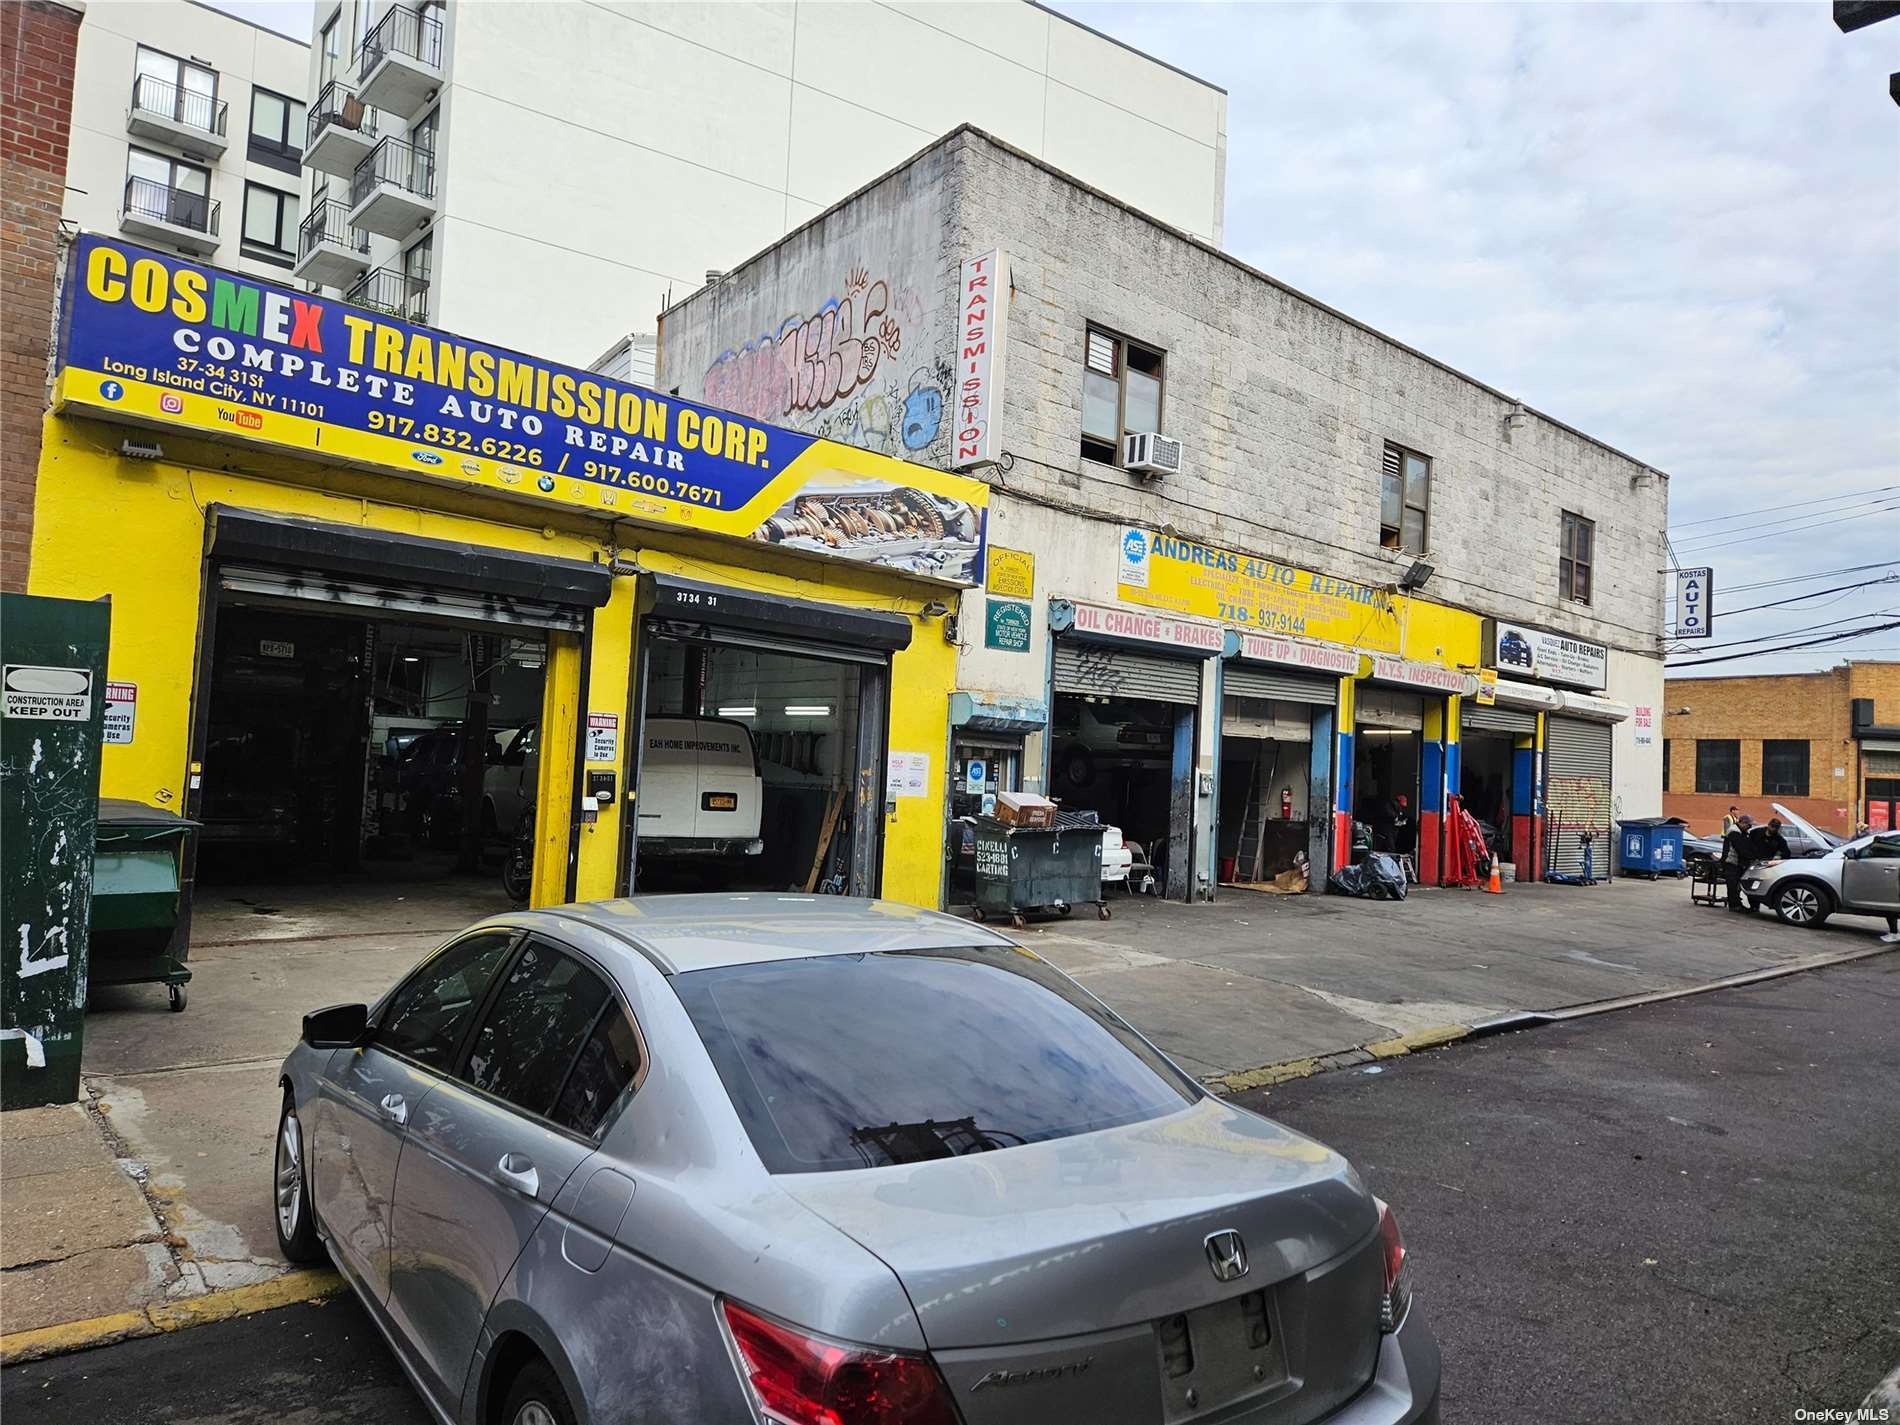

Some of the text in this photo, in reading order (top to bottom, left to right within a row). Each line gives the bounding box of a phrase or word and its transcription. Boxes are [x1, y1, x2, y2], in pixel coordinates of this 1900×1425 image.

[87, 246, 769, 468] COSMEX TRANSMISSION CORP.
[959, 257, 988, 459] TRANSMISSION
[177, 357, 265, 388] 37-34 31St
[103, 357, 324, 418] Long Island City, NY 11101
[173, 328, 685, 471] COMPLETE AUTO REPAIR
[217, 407, 262, 429] YouTube
[367, 410, 542, 465] 917.832.6226
[583, 461, 721, 506] 917.600.7671
[417, 452, 438, 465] Ford
[1126, 539, 1144, 554] ASE
[993, 553, 1030, 571] OFFICIAL
[1150, 535, 1238, 573] ANDREAS
[1242, 559, 1295, 586] AUTO
[1679, 569, 1706, 578] KOSTAS
[677, 592, 717, 607] 3734 31
[1684, 580, 1699, 627] AUTO
[993, 604, 1030, 626] REGISTERED
[1077, 608, 1100, 629] OIL
[1104, 615, 1161, 639] CHANGE
[1174, 624, 1222, 649] BRAKES
[1678, 627, 1705, 635] REPAIRS
[1247, 640, 1356, 670] TUNE UP DIAGNOSTIC
[1560, 640, 1577, 653] AUTO
[1579, 643, 1604, 660] REPAIRS
[1377, 660, 1405, 679] N.Y.S.
[1408, 667, 1466, 691] INSPECTION
[7, 695, 85, 708] CONSTRUCTION AREA
[106, 687, 134, 701] RNING
[9, 706, 81, 718] KEEP OUT
[104, 715, 130, 723] ecurity
[590, 717, 617, 728] WARNING
[664, 740, 683, 750] HOME
[684, 741, 730, 753] IMPROVEMENTS
[976, 863, 1009, 877] CARTING
